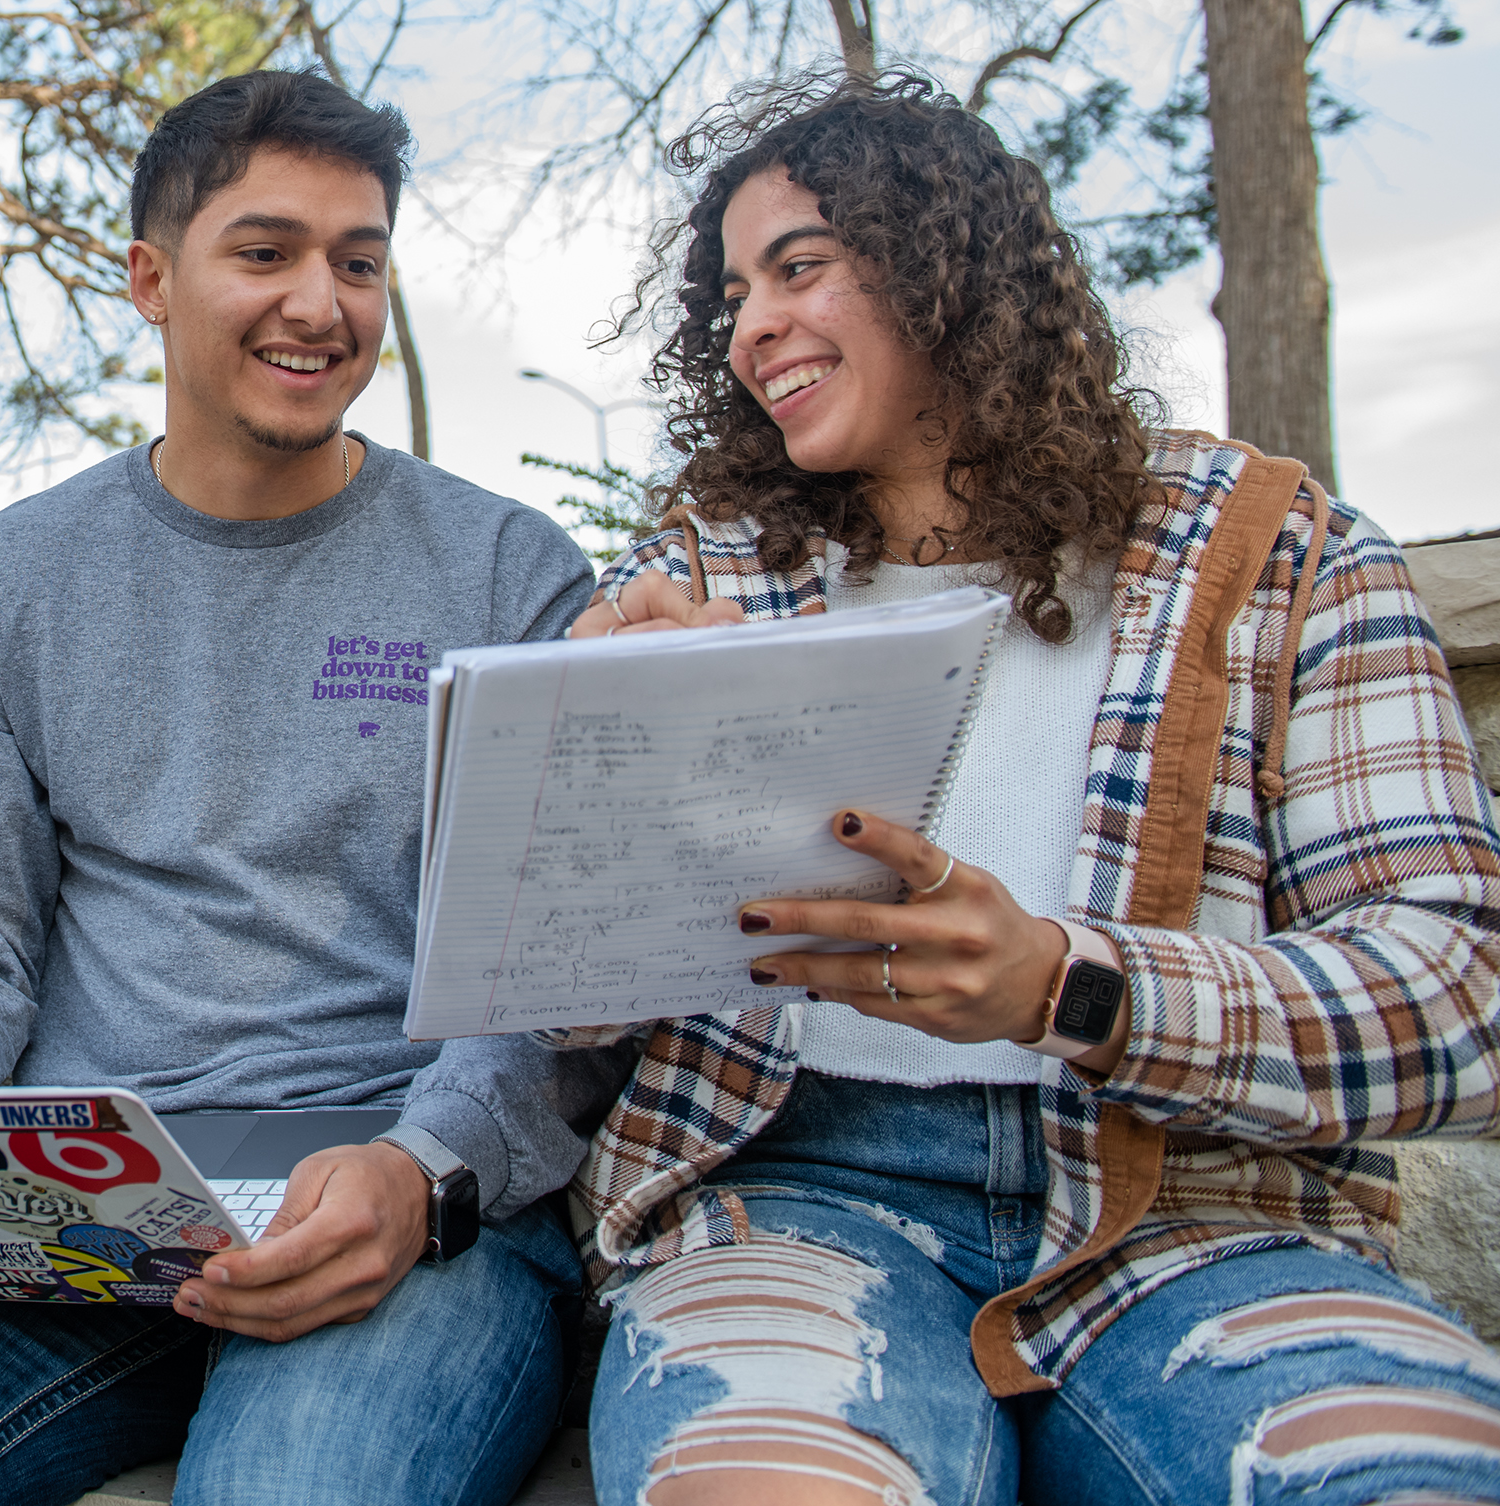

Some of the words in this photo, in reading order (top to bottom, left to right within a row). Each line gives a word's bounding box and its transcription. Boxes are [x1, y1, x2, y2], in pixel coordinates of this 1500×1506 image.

[327, 635, 380, 656] let's
[384, 641, 427, 660] get
[321, 657, 396, 678] down
[401, 662, 429, 682] to
[312, 679, 429, 706] business
[159, 1208, 212, 1243] CUPOARD
[150, 1258, 203, 1277] EMPOWERM
